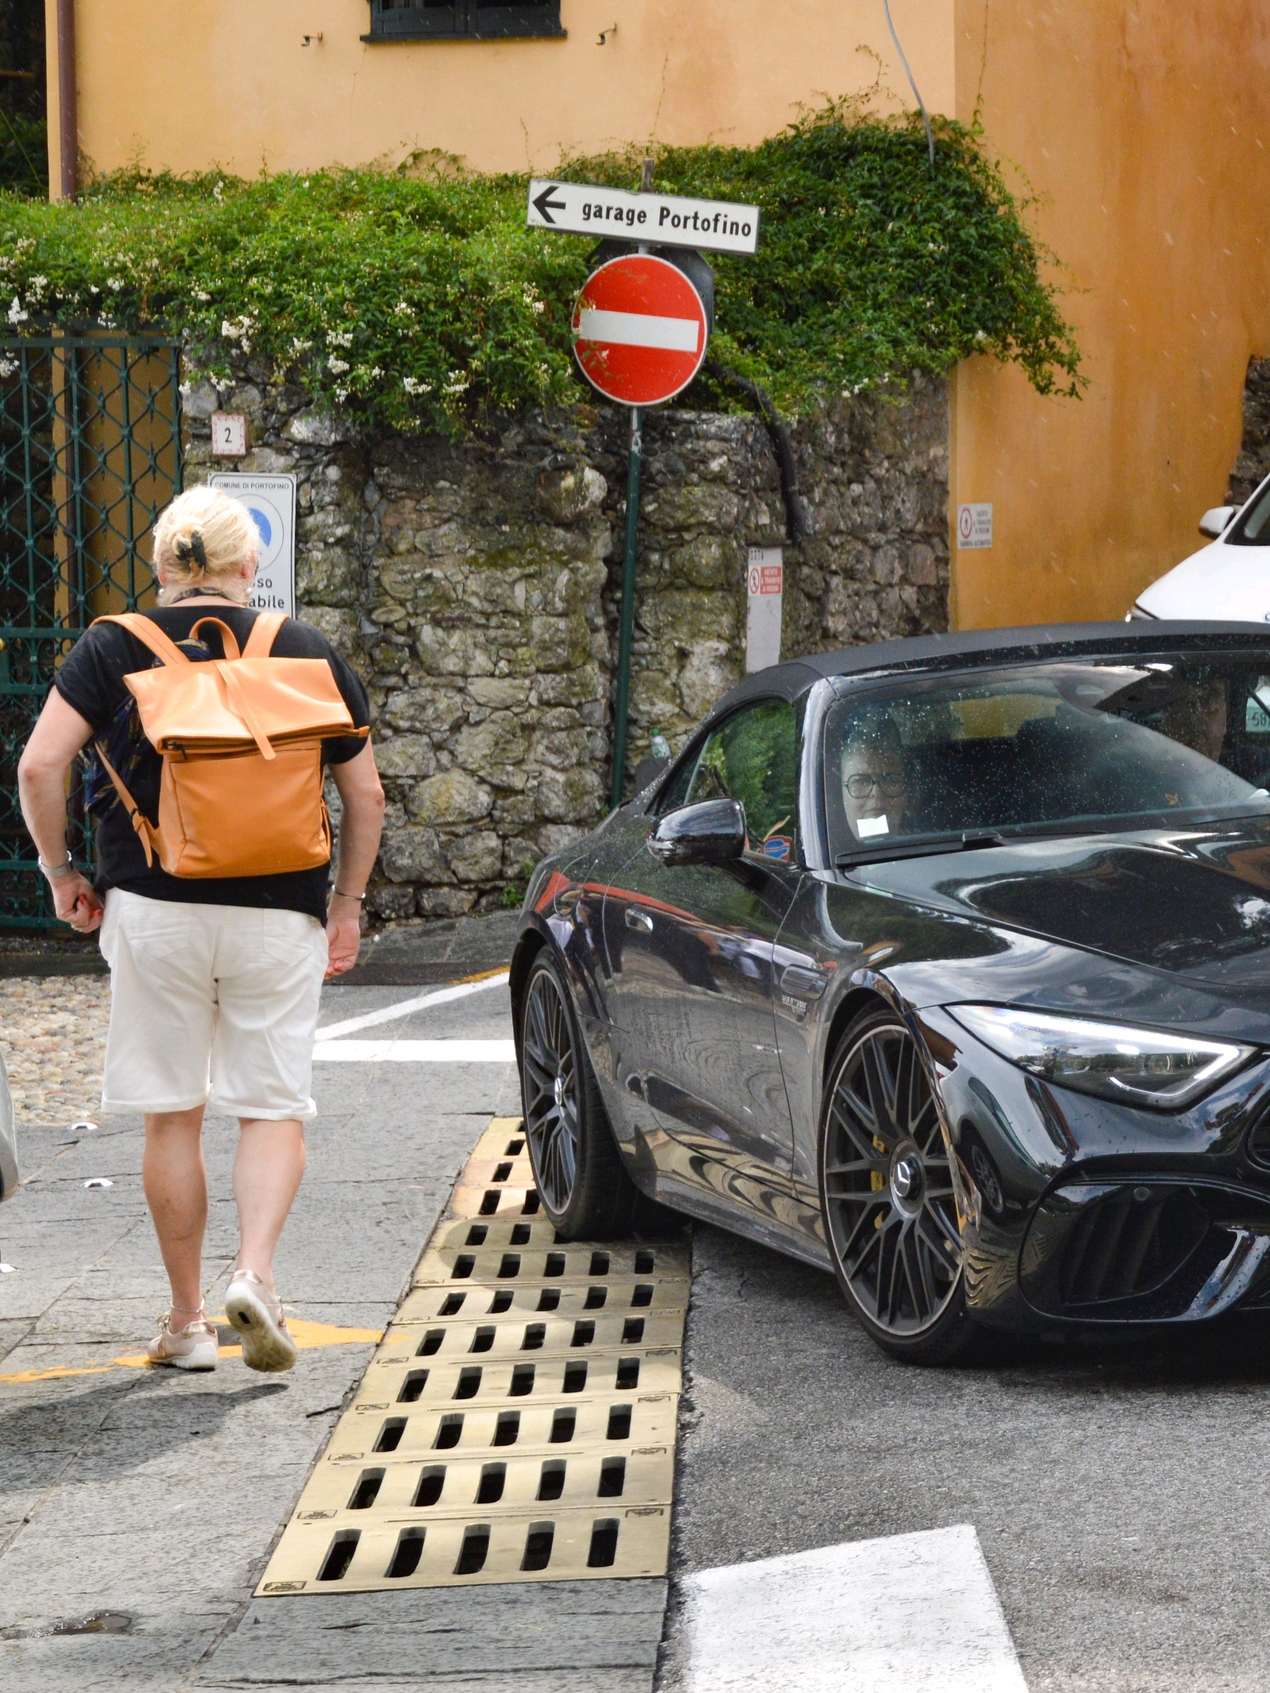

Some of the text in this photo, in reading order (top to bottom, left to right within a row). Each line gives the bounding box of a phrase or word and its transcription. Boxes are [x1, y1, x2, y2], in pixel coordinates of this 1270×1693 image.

[582, 202, 752, 237] garage Portofino
[224, 427, 233, 443] 2
[214, 481, 290, 490] COMUNE DI PORTOFINO
[253, 578, 273, 588] so
